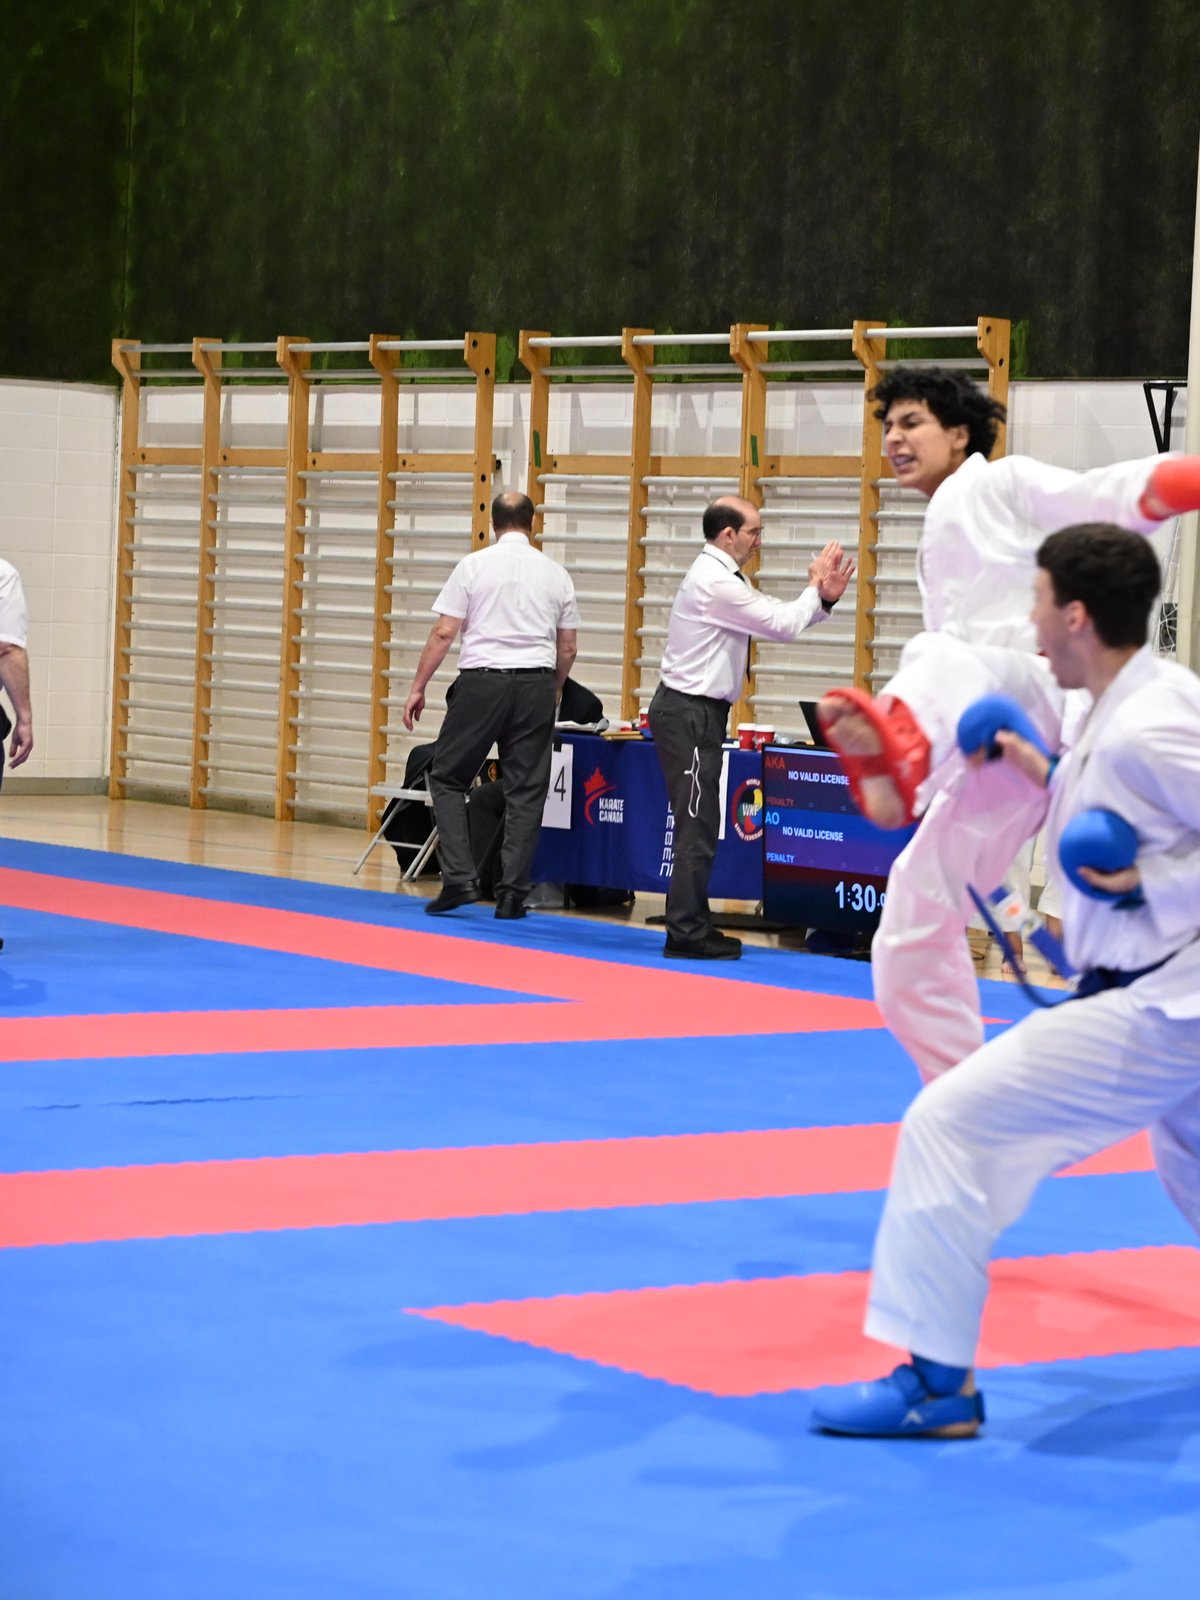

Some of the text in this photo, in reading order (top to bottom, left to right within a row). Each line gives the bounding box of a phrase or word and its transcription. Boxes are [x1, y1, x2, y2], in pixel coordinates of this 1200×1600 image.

[765, 756, 785, 769] AKA
[554, 765, 566, 802] 4
[788, 770, 850, 785] NO VALID LICENSE
[599, 798, 624, 811] KARATE
[766, 796, 794, 807] PENALTY
[742, 803, 759, 816] WKF
[599, 810, 624, 824] CANADA
[765, 812, 780, 825] AO
[783, 826, 843, 841] NO VALID LICENSE
[767, 852, 794, 863] PENALTY
